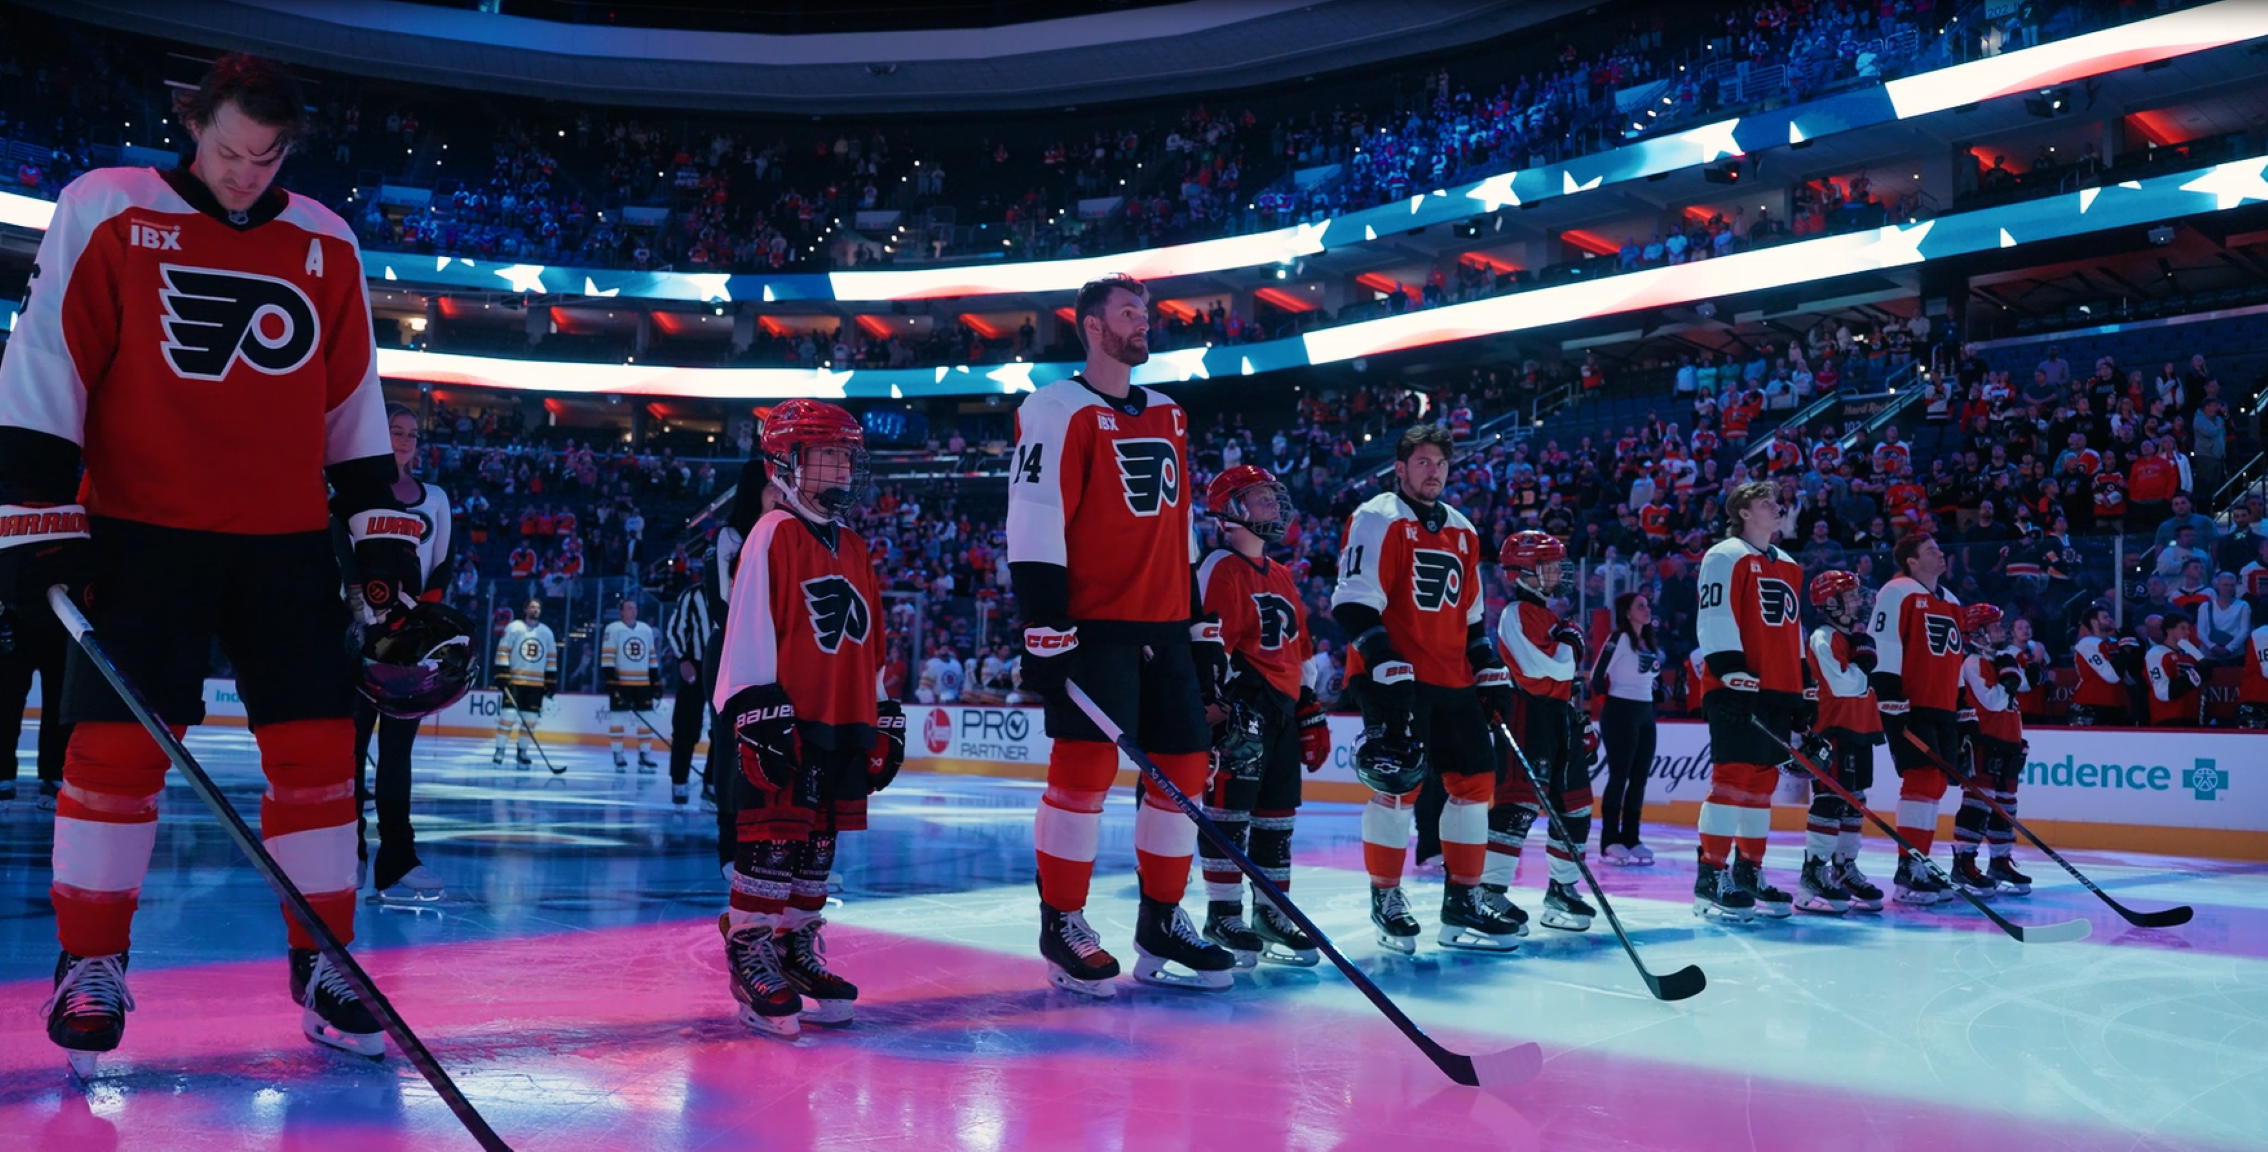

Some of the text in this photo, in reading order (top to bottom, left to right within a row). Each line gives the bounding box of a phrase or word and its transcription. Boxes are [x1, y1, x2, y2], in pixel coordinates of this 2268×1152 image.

[130, 225, 182, 250] IBX
[305, 238, 324, 278] A
[1097, 415, 1119, 431] IBX
[1171, 409, 1184, 437] C
[1458, 531, 1469, 555] A
[1346, 545, 1364, 578] 11
[1700, 582, 1723, 609] 20
[961, 708, 1030, 743] PRO
[961, 742, 1030, 761] PARTNER
